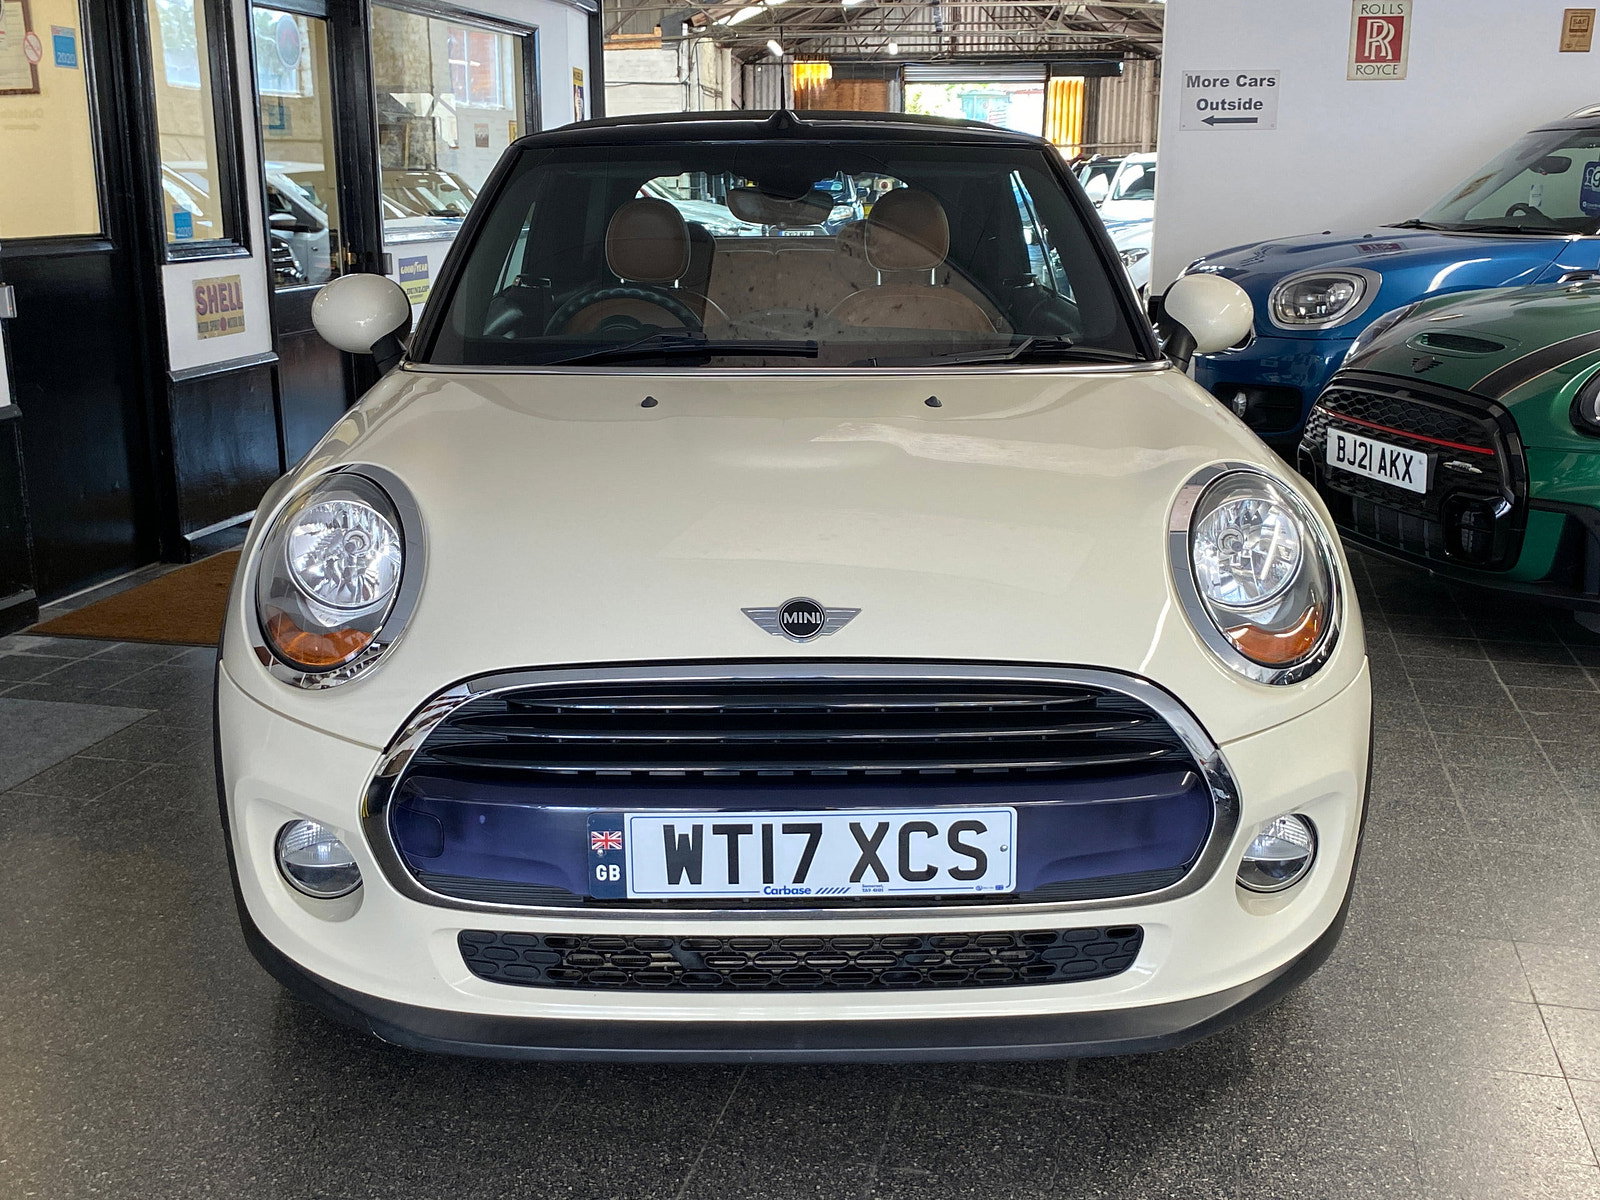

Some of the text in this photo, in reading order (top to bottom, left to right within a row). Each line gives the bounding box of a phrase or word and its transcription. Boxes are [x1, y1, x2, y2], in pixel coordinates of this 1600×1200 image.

[1361, 4, 1404, 15] ROLLS
[1355, 64, 1399, 76] ROYCE
[1186, 74, 1276, 88] More Cars
[1196, 98, 1264, 111] Outside
[195, 281, 244, 316] SHELL
[1336, 435, 1414, 484] BJ21 AKX
[783, 611, 821, 624] MINI
[663, 819, 988, 886] WT17 XCS
[595, 864, 621, 882] GB
[763, 885, 812, 895] Carbase
